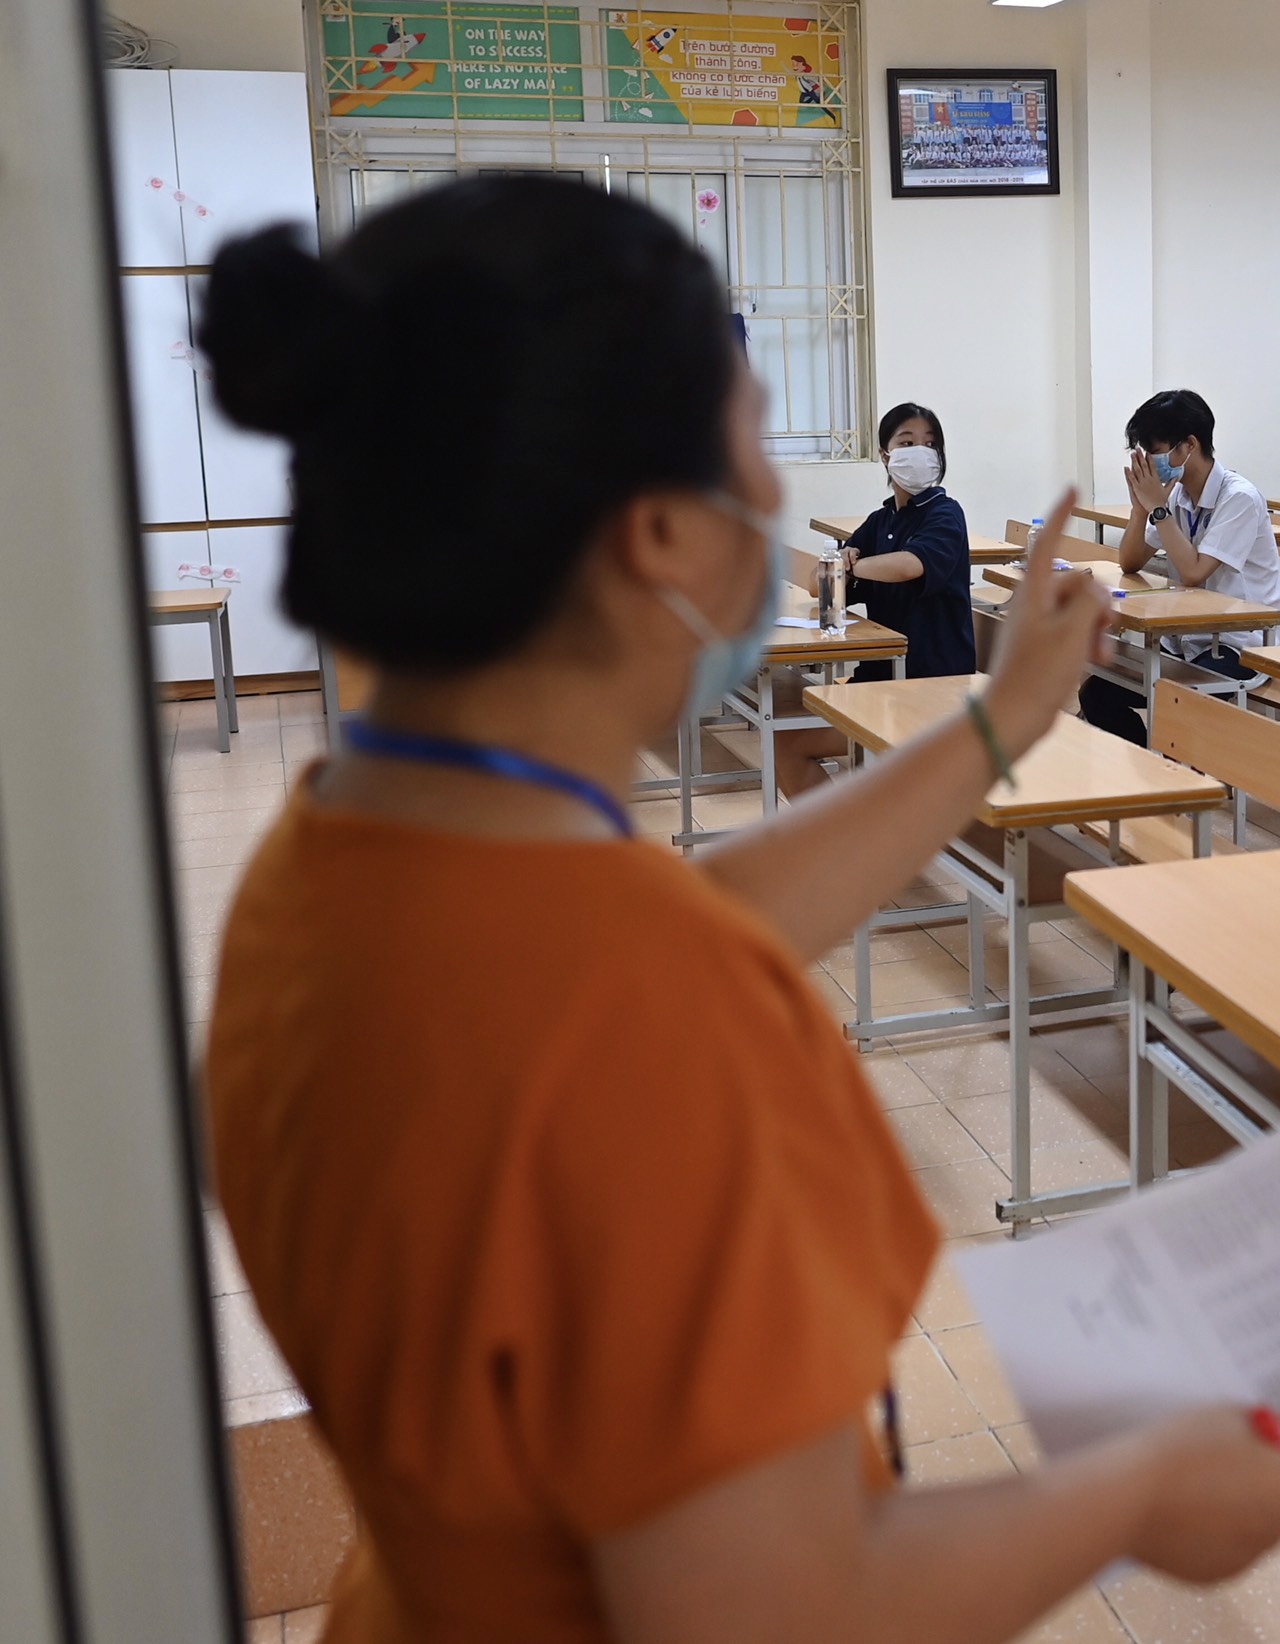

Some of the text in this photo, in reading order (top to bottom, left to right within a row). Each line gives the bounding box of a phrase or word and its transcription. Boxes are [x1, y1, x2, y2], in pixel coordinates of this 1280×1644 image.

[465, 28, 484, 40] ON
[514, 30, 546, 41] WAY
[468, 45, 485, 56] TO
[490, 64, 501, 73] IS
[505, 64, 524, 73] NO
[464, 78, 481, 89] OF
[485, 78, 520, 90] LAZY
[681, 85, 702, 96] của
[705, 86, 719, 97] kẻ
[746, 87, 777, 100] biếng
